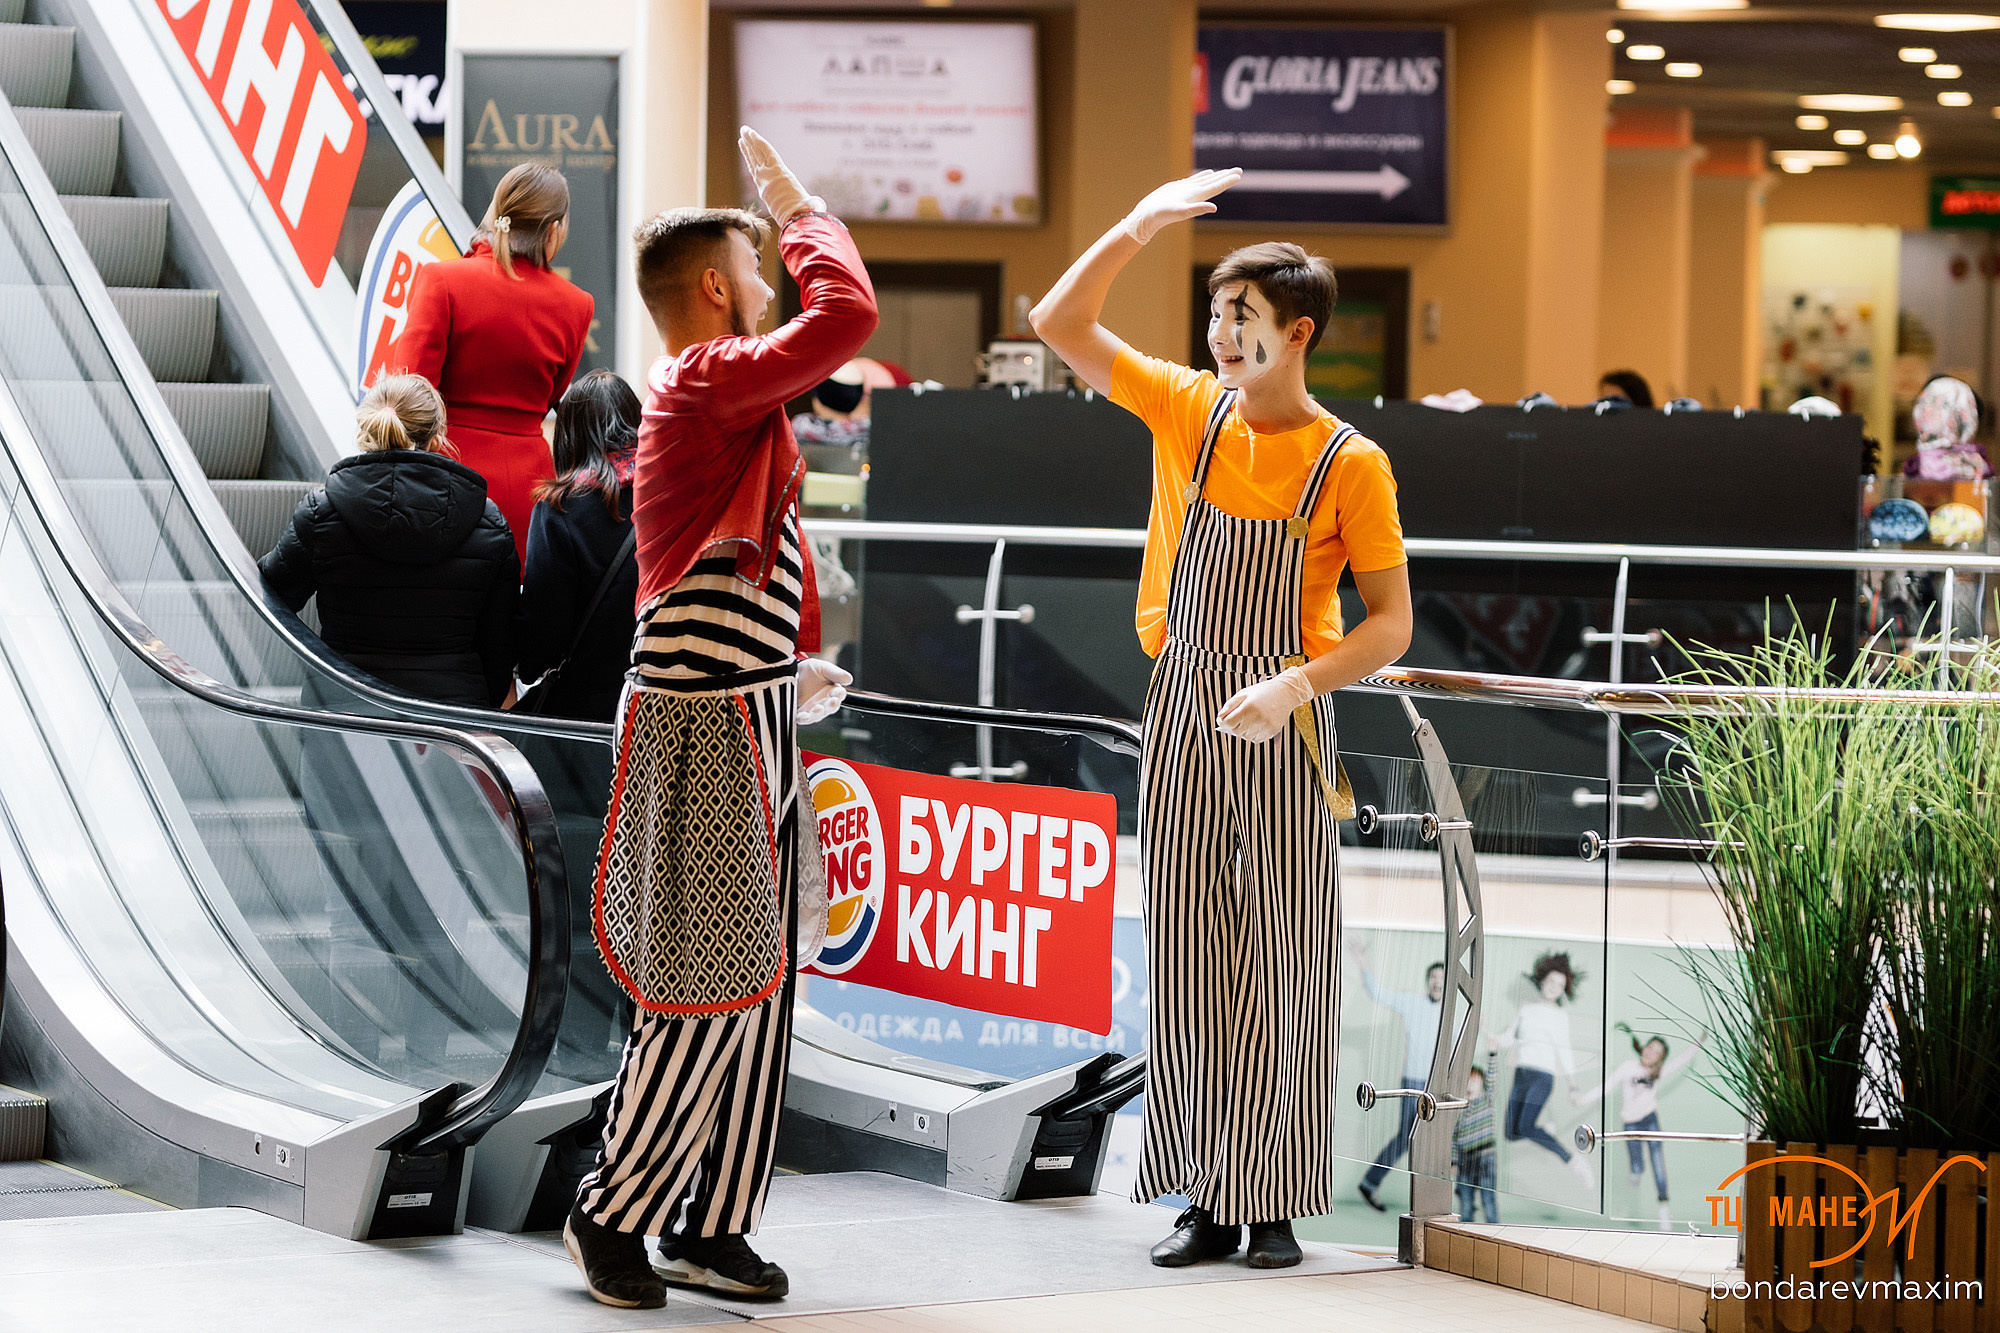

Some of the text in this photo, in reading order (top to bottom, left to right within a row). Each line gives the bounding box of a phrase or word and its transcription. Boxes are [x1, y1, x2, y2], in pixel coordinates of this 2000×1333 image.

[1221, 55, 1441, 112] GLORIA JEANS
[466, 98, 615, 151] AURA
[822, 841, 872, 901] NG
[899, 795, 1111, 903] БУРГЕР
[896, 884, 1052, 988] КИНГ
[835, 1011, 964, 1045] ОДЕЖДА
[977, 1020, 1039, 1048] ДЛЯ
[1053, 1024, 1126, 1051] ВСЕЙ
